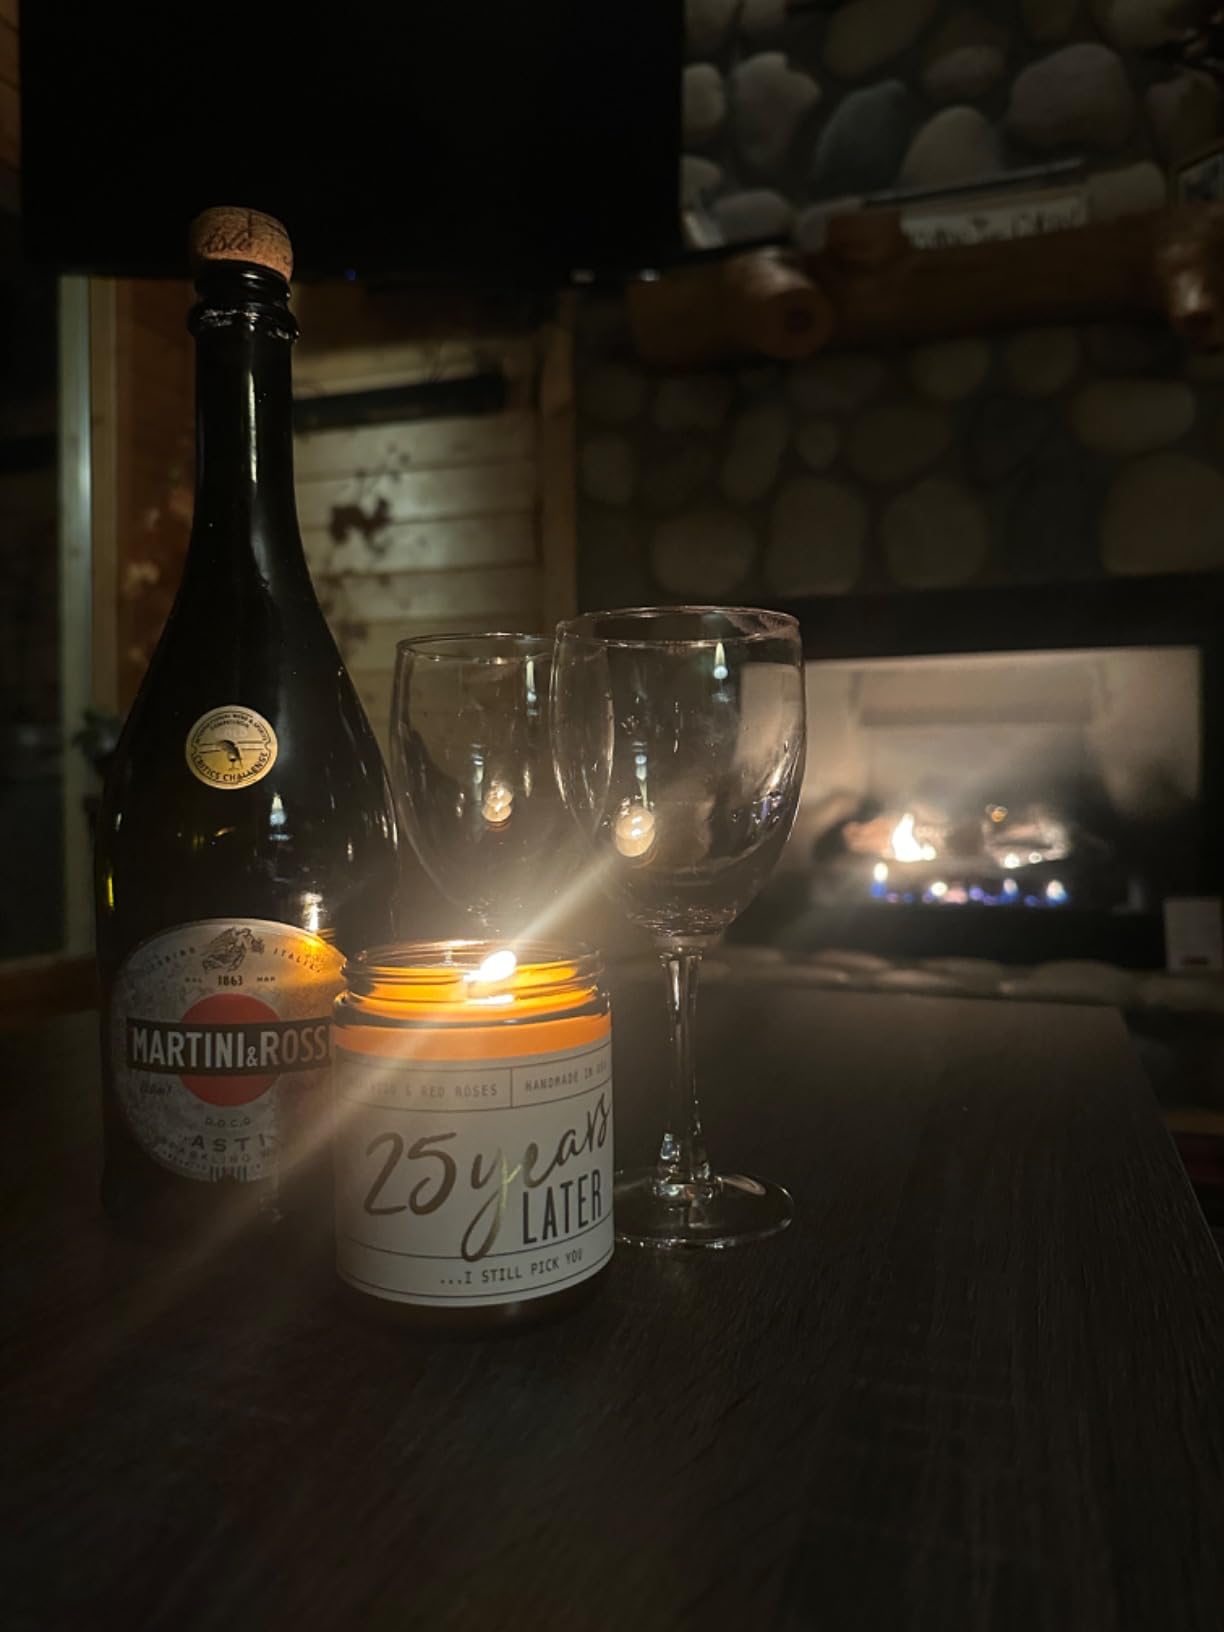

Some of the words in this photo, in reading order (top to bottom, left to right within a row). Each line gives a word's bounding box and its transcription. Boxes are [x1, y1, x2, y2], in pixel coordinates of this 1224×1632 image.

[217, 975, 243, 986] 1863
[420, 1084, 446, 1099] RED
[455, 1083, 498, 1098] ROSES
[524, 1070, 579, 1092] HANDMADE
[191, 1133, 265, 1152] ASTI
[363, 1132, 458, 1216] 25
[460, 1091, 612, 1263] years
[522, 1168, 603, 1245] LATER
[481, 1267, 523, 1284] STILL
[531, 1255, 560, 1276] PICK
[565, 1247, 584, 1265] YOU
